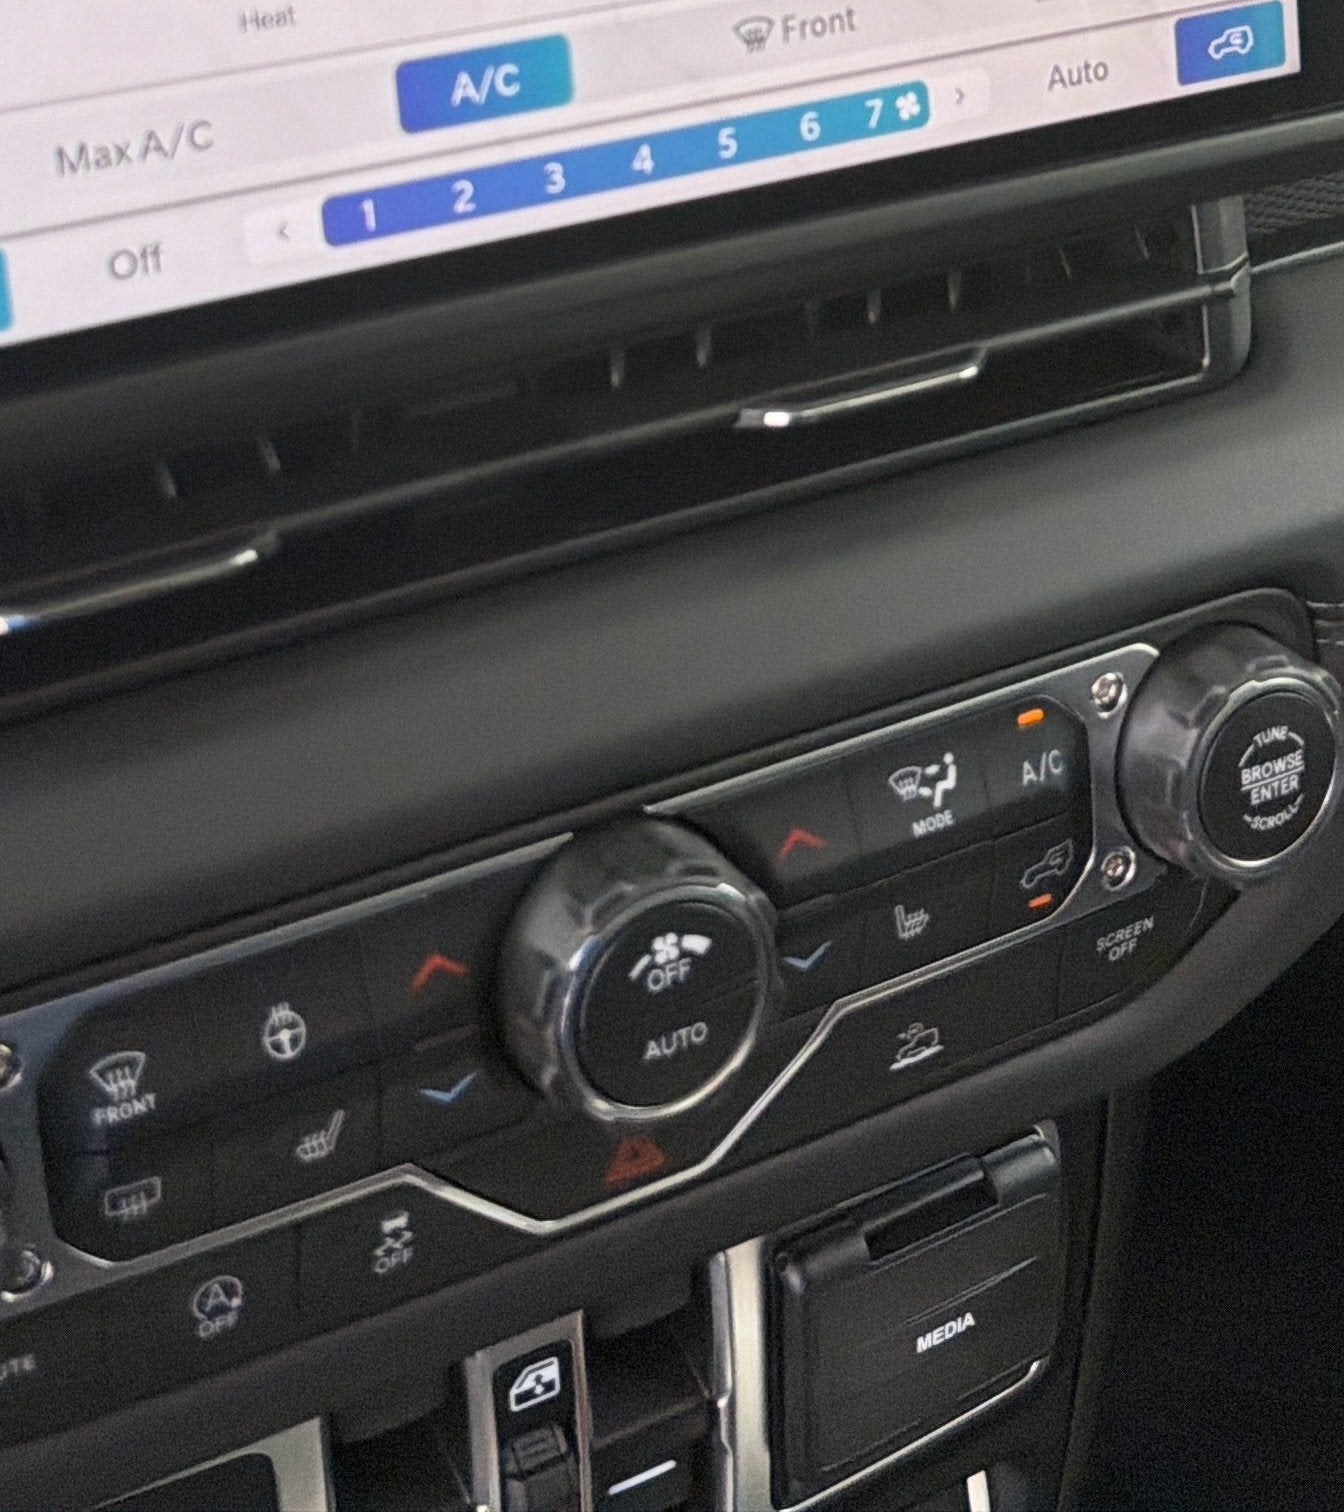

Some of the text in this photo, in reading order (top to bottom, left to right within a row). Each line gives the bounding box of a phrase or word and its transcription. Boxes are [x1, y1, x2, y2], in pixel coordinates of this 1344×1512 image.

[237, 4, 297, 35] Heat
[780, 7, 858, 43] Front
[450, 61, 522, 107] A/C
[1046, 59, 1109, 92] Auto
[55, 118, 216, 179] Max A/C
[360, 97, 884, 232] 1 2 3 4 5 6 7
[107, 240, 165, 283] Off
[1253, 724, 1289, 750] TUNE
[1021, 747, 1065, 786] A/C
[1240, 749, 1305, 786] BROWSE
[1249, 775, 1300, 807] ENTER
[911, 809, 955, 839] MODE
[1250, 799, 1301, 831] SCROLL
[1095, 915, 1155, 954] SCREEN
[1107, 935, 1139, 962] OFF
[646, 956, 693, 994] OFF
[642, 1019, 709, 1062] AUTO
[92, 1090, 157, 1127] FRONT
[373, 1246, 414, 1276] OFF
[198, 1311, 239, 1340] OFF
[915, 1311, 976, 1355] MEDIA
